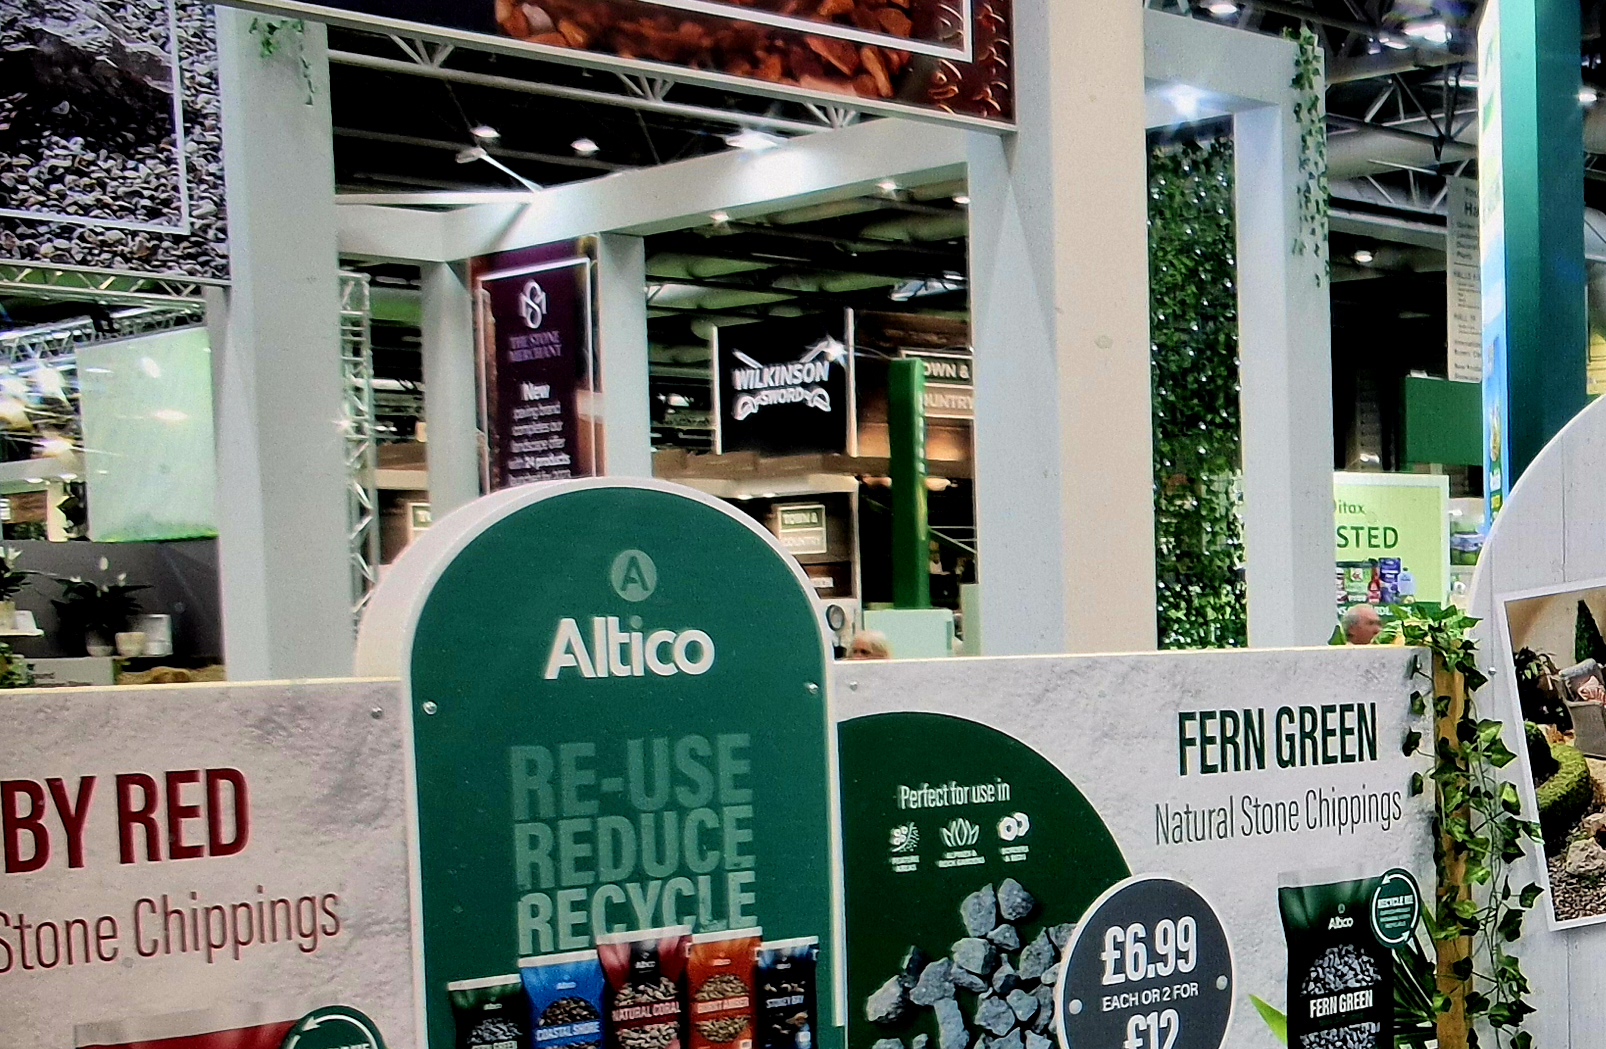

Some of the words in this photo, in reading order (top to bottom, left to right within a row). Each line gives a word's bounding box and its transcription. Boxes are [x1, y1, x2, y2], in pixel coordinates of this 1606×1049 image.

[732, 361, 830, 390] WILKINSON
[924, 362, 957, 377] OWN
[520, 381, 551, 401] New
[762, 386, 803, 405] SWORD
[1336, 526, 1399, 549] STED
[544, 614, 715, 679] Altico
[1178, 708, 1266, 776] FERN
[1275, 702, 1377, 769] GREEN
[509, 733, 753, 821] RE-USE
[897, 782, 949, 809] Perfect
[950, 780, 970, 805] for
[971, 783, 996, 804] use
[996, 777, 1011, 802] in
[116, 767, 251, 865] RED
[1155, 795, 1235, 845] Natural
[1241, 795, 1299, 836] Stone
[1305, 784, 1402, 836] Chippings
[514, 805, 757, 889] REDUCE
[134, 885, 342, 964] Chippings
[517, 870, 759, 955] RECYCLE
[1328, 916, 1354, 931] Altico
[1100, 915, 1198, 986] £6.99
[611, 1003, 651, 1023] NATURAL
[652, 1000, 681, 1016] CORAL
[1102, 992, 1139, 1012] EACH
[1141, 988, 1161, 1005] OR
[1161, 986, 1171, 1002] 2
[1173, 982, 1199, 999] FOR
[1309, 996, 1337, 1019] FERN
[1338, 989, 1373, 1014] GREEN
